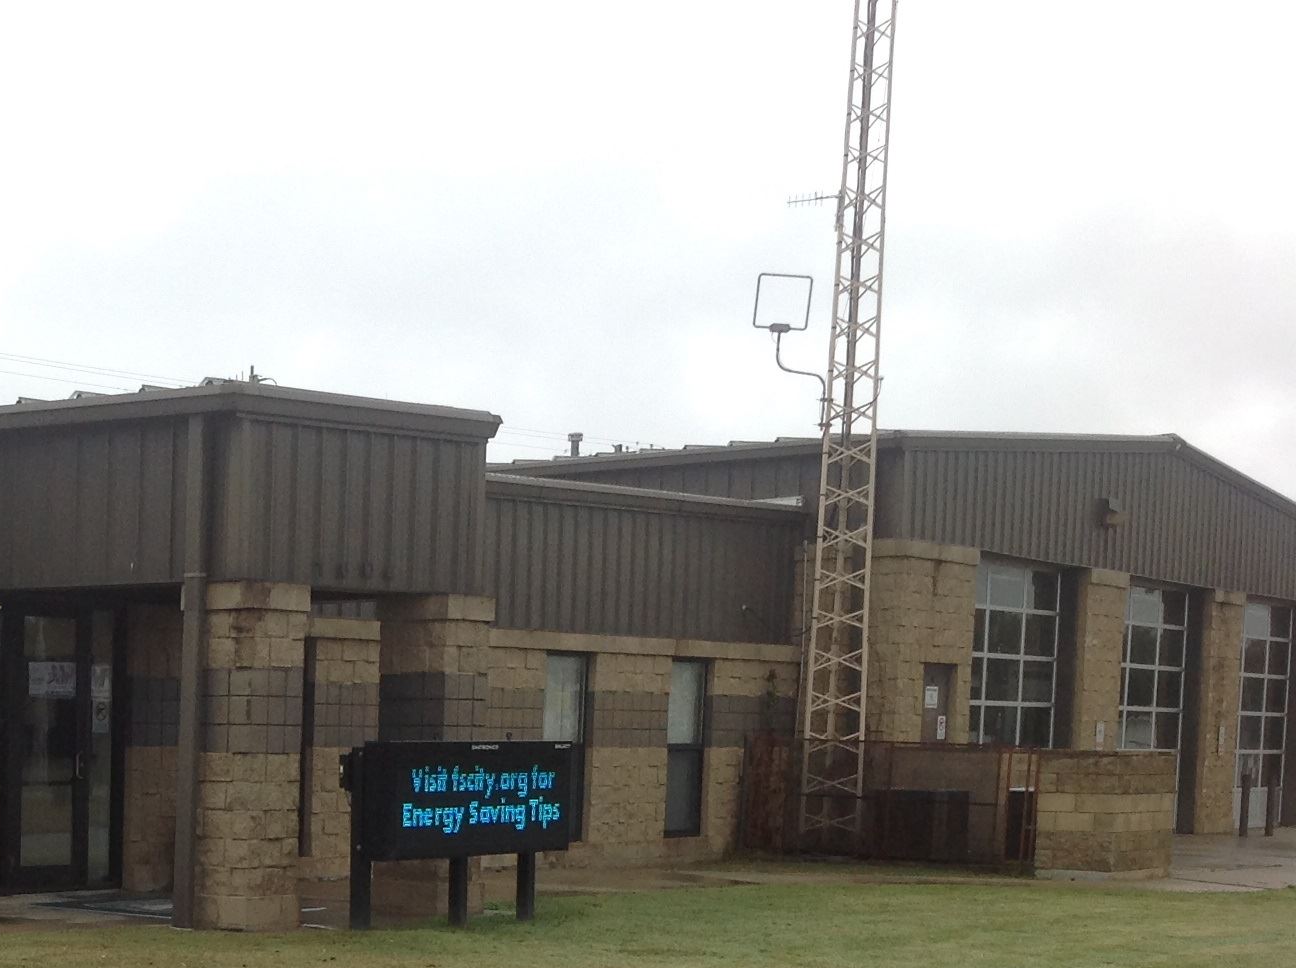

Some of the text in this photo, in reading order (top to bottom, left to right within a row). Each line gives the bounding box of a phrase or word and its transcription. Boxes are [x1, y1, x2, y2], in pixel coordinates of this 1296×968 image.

[411, 766, 447, 792] Visit
[532, 764, 556, 789] for
[402, 796, 560, 833] Energy Saving Tips
